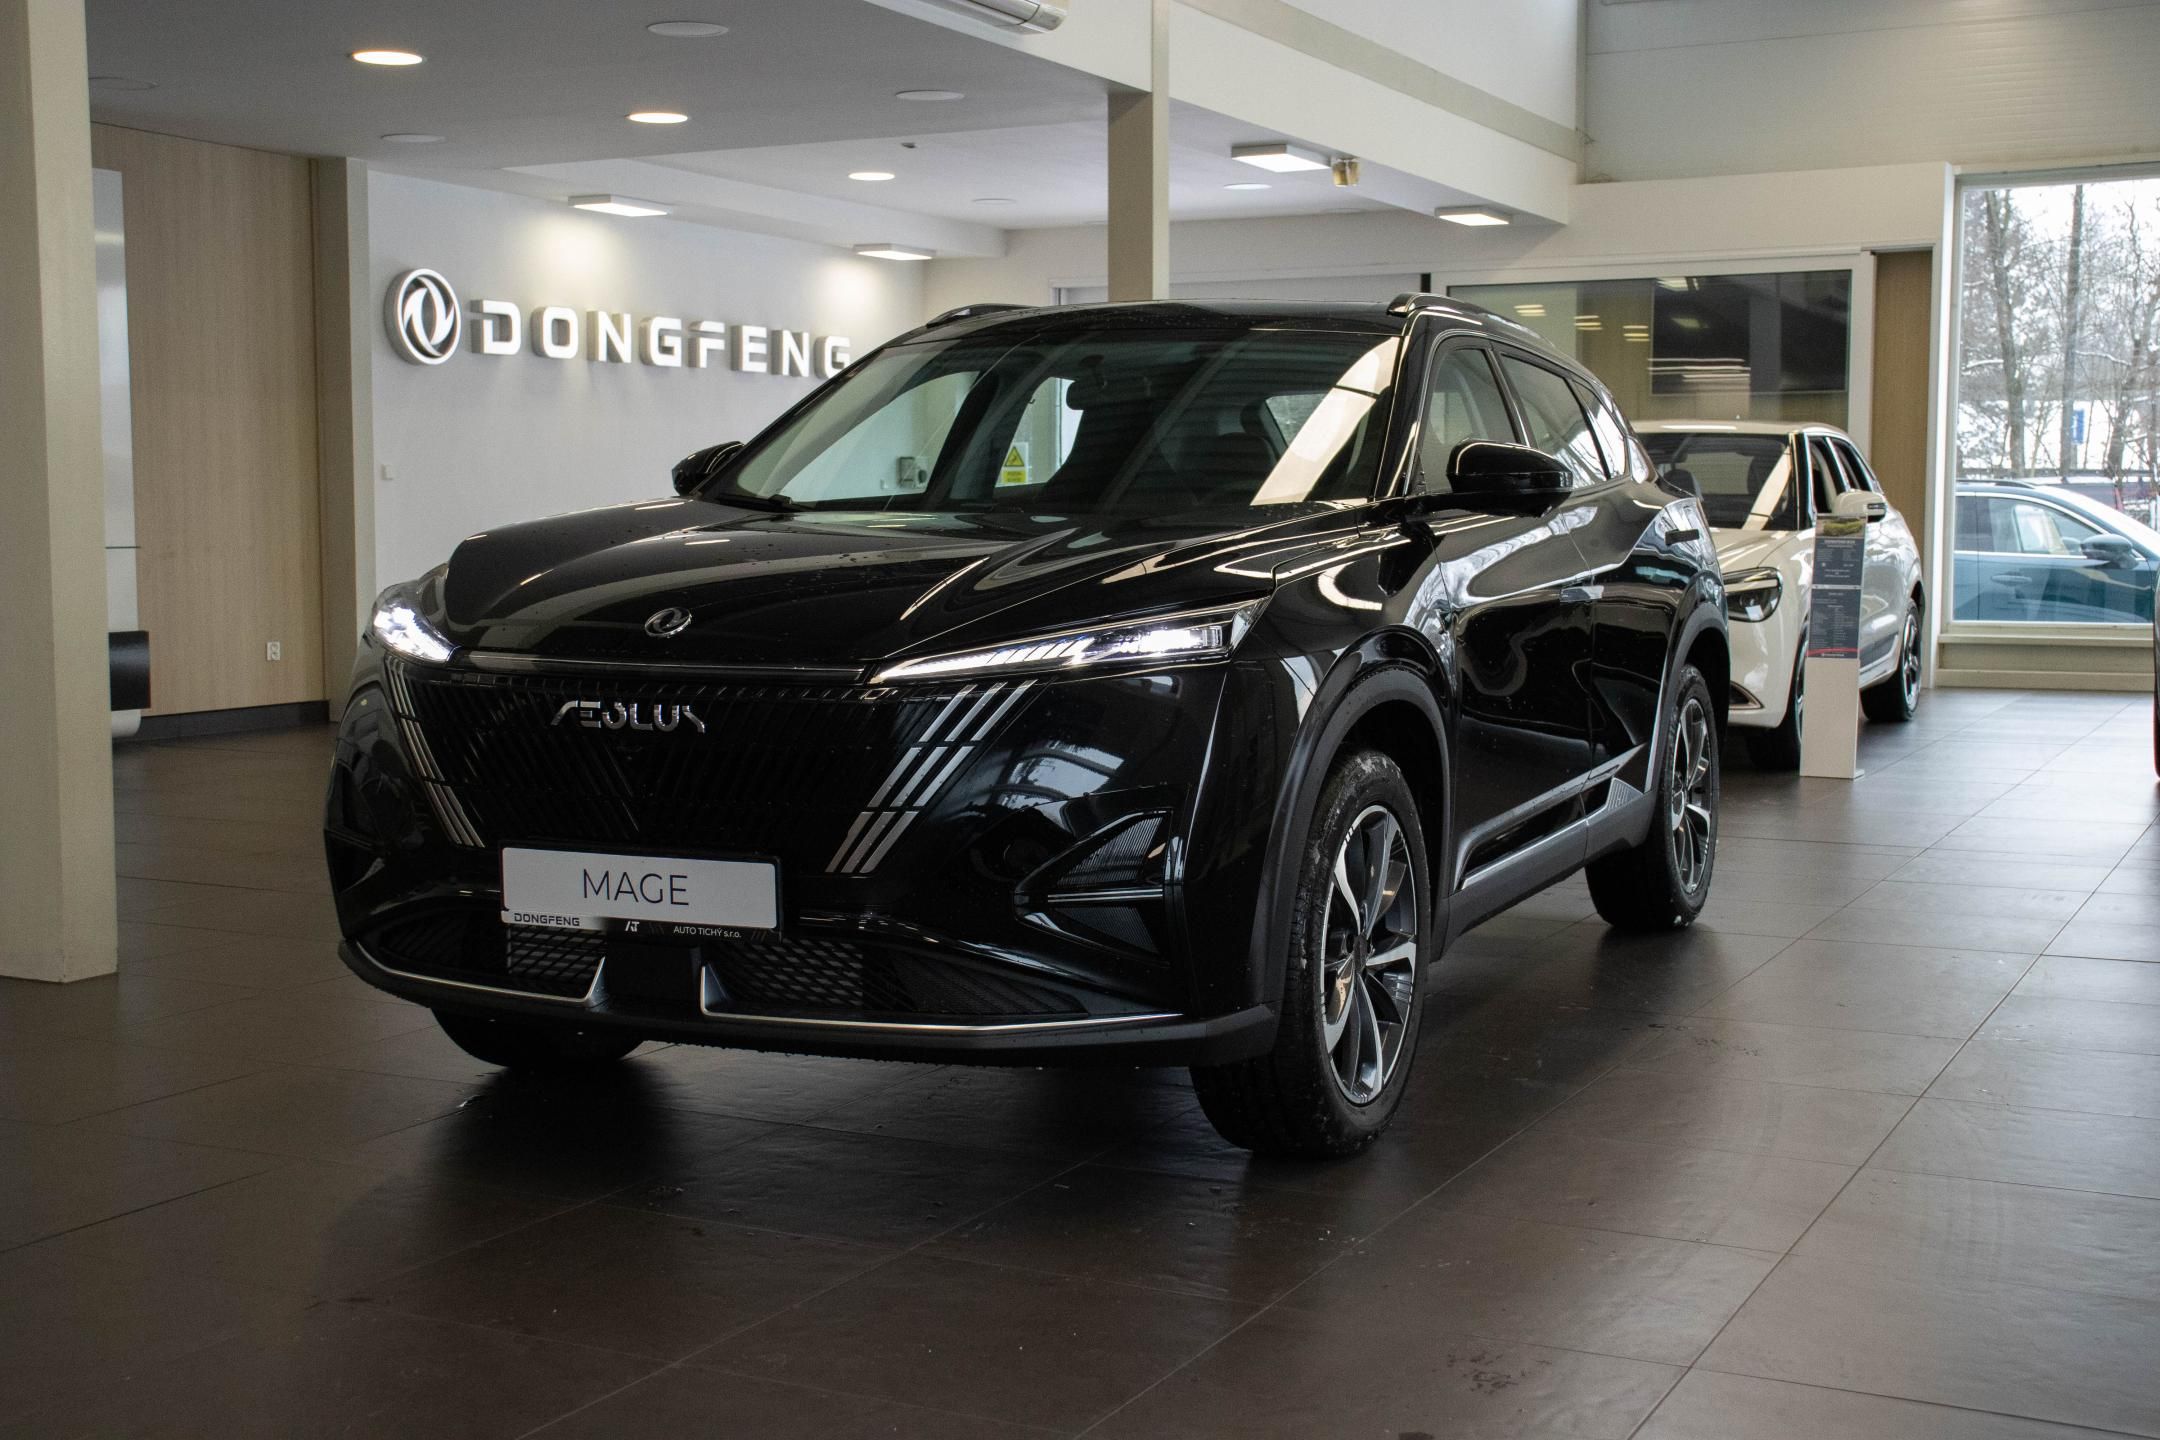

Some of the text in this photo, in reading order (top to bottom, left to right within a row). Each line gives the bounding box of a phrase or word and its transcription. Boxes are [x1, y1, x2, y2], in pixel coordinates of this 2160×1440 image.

[471, 299, 851, 379] DONGFENG
[582, 868, 690, 906] MAGE
[514, 912, 580, 927] DONGFENG
[673, 926, 697, 935] AUTO
[698, 927, 722, 937] TICHÝ
